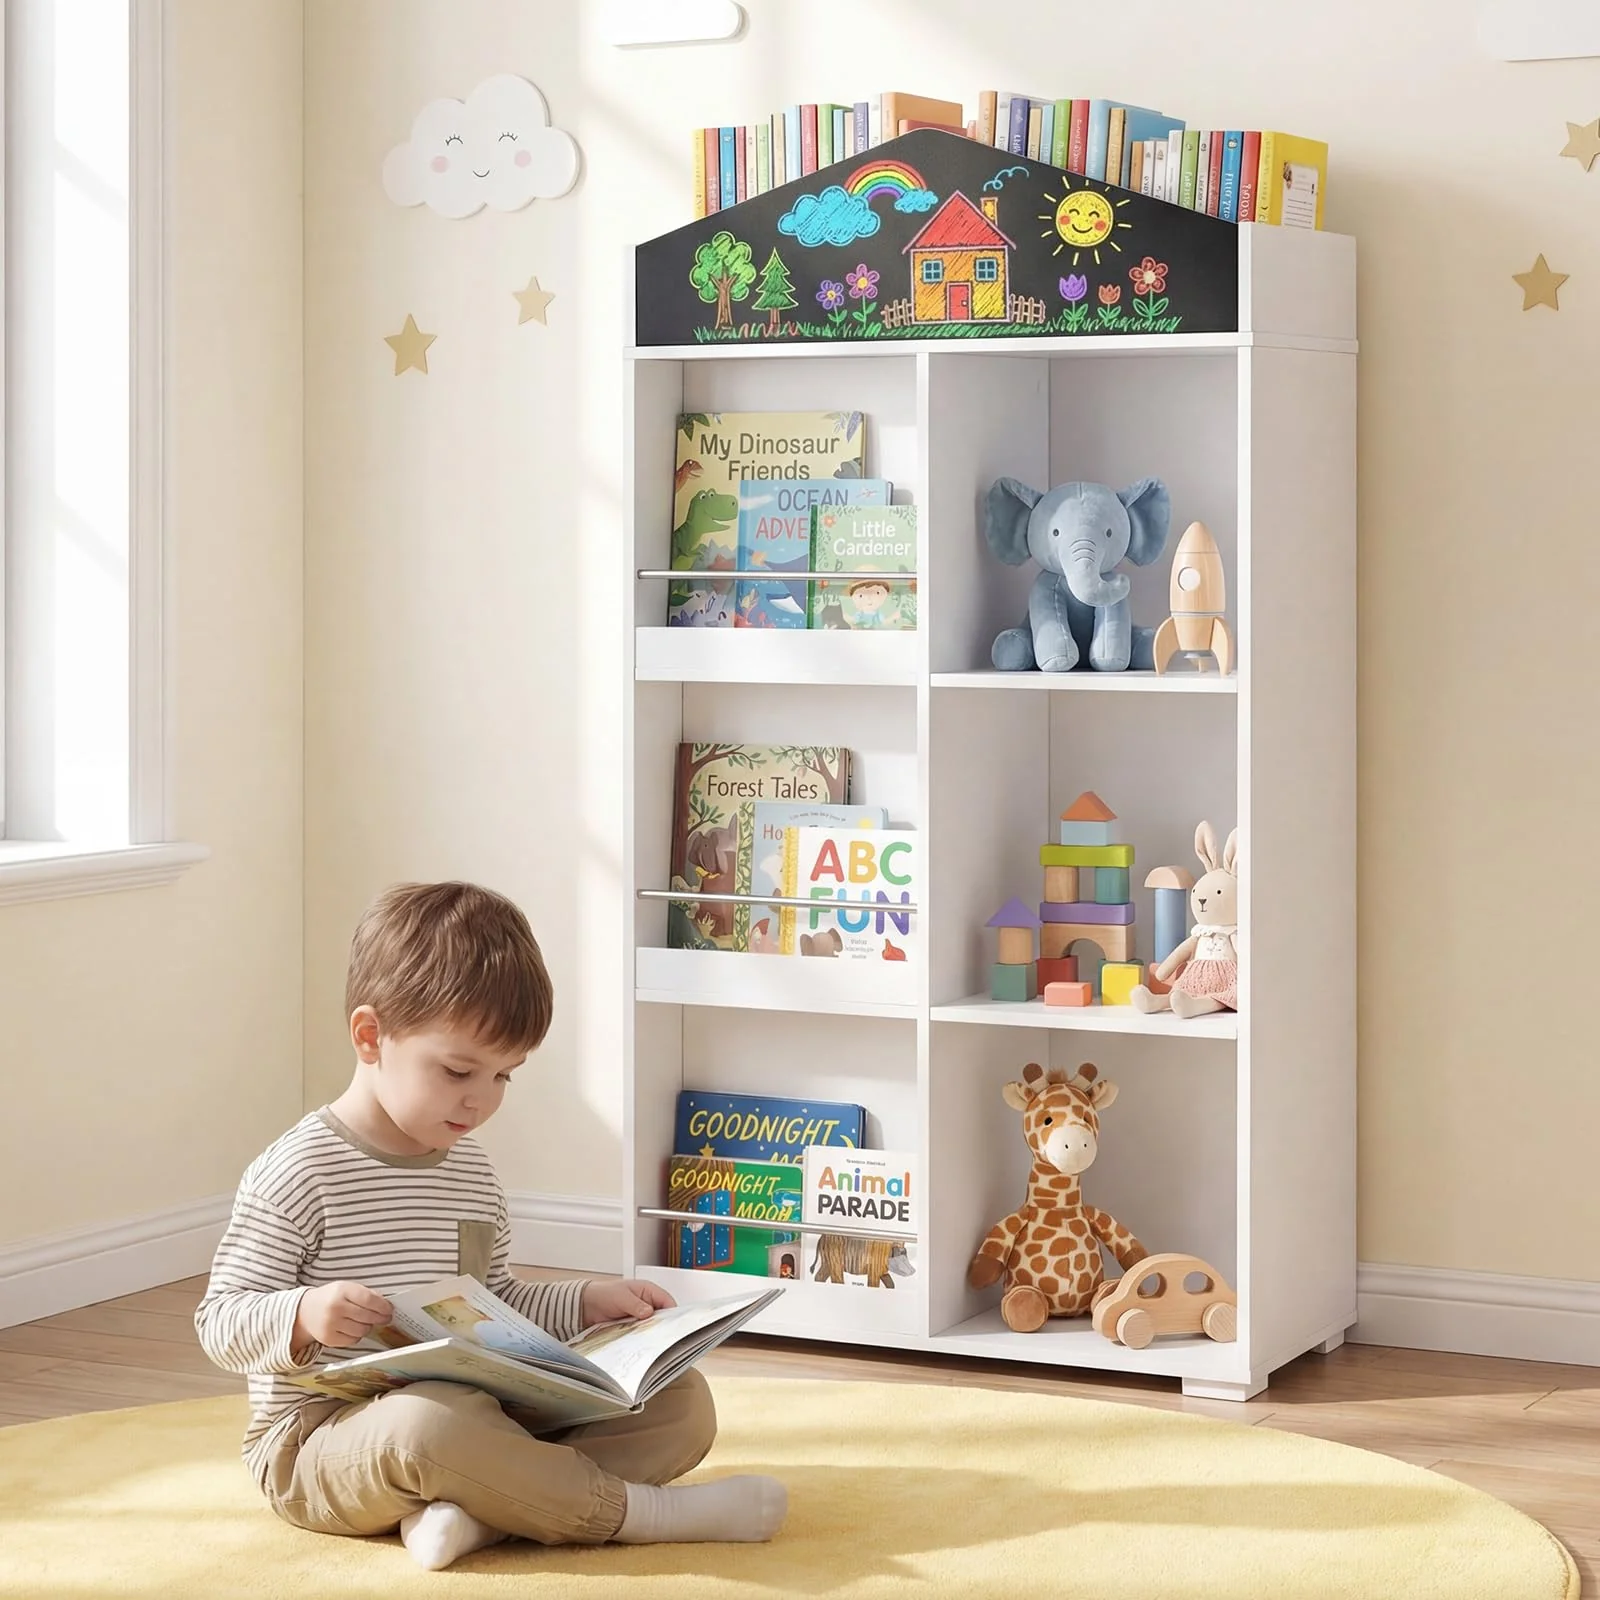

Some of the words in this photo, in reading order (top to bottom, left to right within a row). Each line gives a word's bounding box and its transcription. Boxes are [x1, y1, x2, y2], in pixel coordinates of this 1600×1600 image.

[700, 434, 732, 461] My
[739, 433, 840, 455] Dinosaur
[728, 460, 811, 481] Friends
[852, 520, 896, 538] Little
[707, 774, 764, 798] Forest
[771, 776, 818, 800] Tales
[810, 839, 913, 886] ABC
[809, 887, 910, 936] FUN
[689, 1110, 840, 1146] GOODNIGHT
[671, 1168, 781, 1196] GOODNIGHT
[818, 1166, 910, 1197] Animal
[817, 1194, 910, 1222] PARADE
